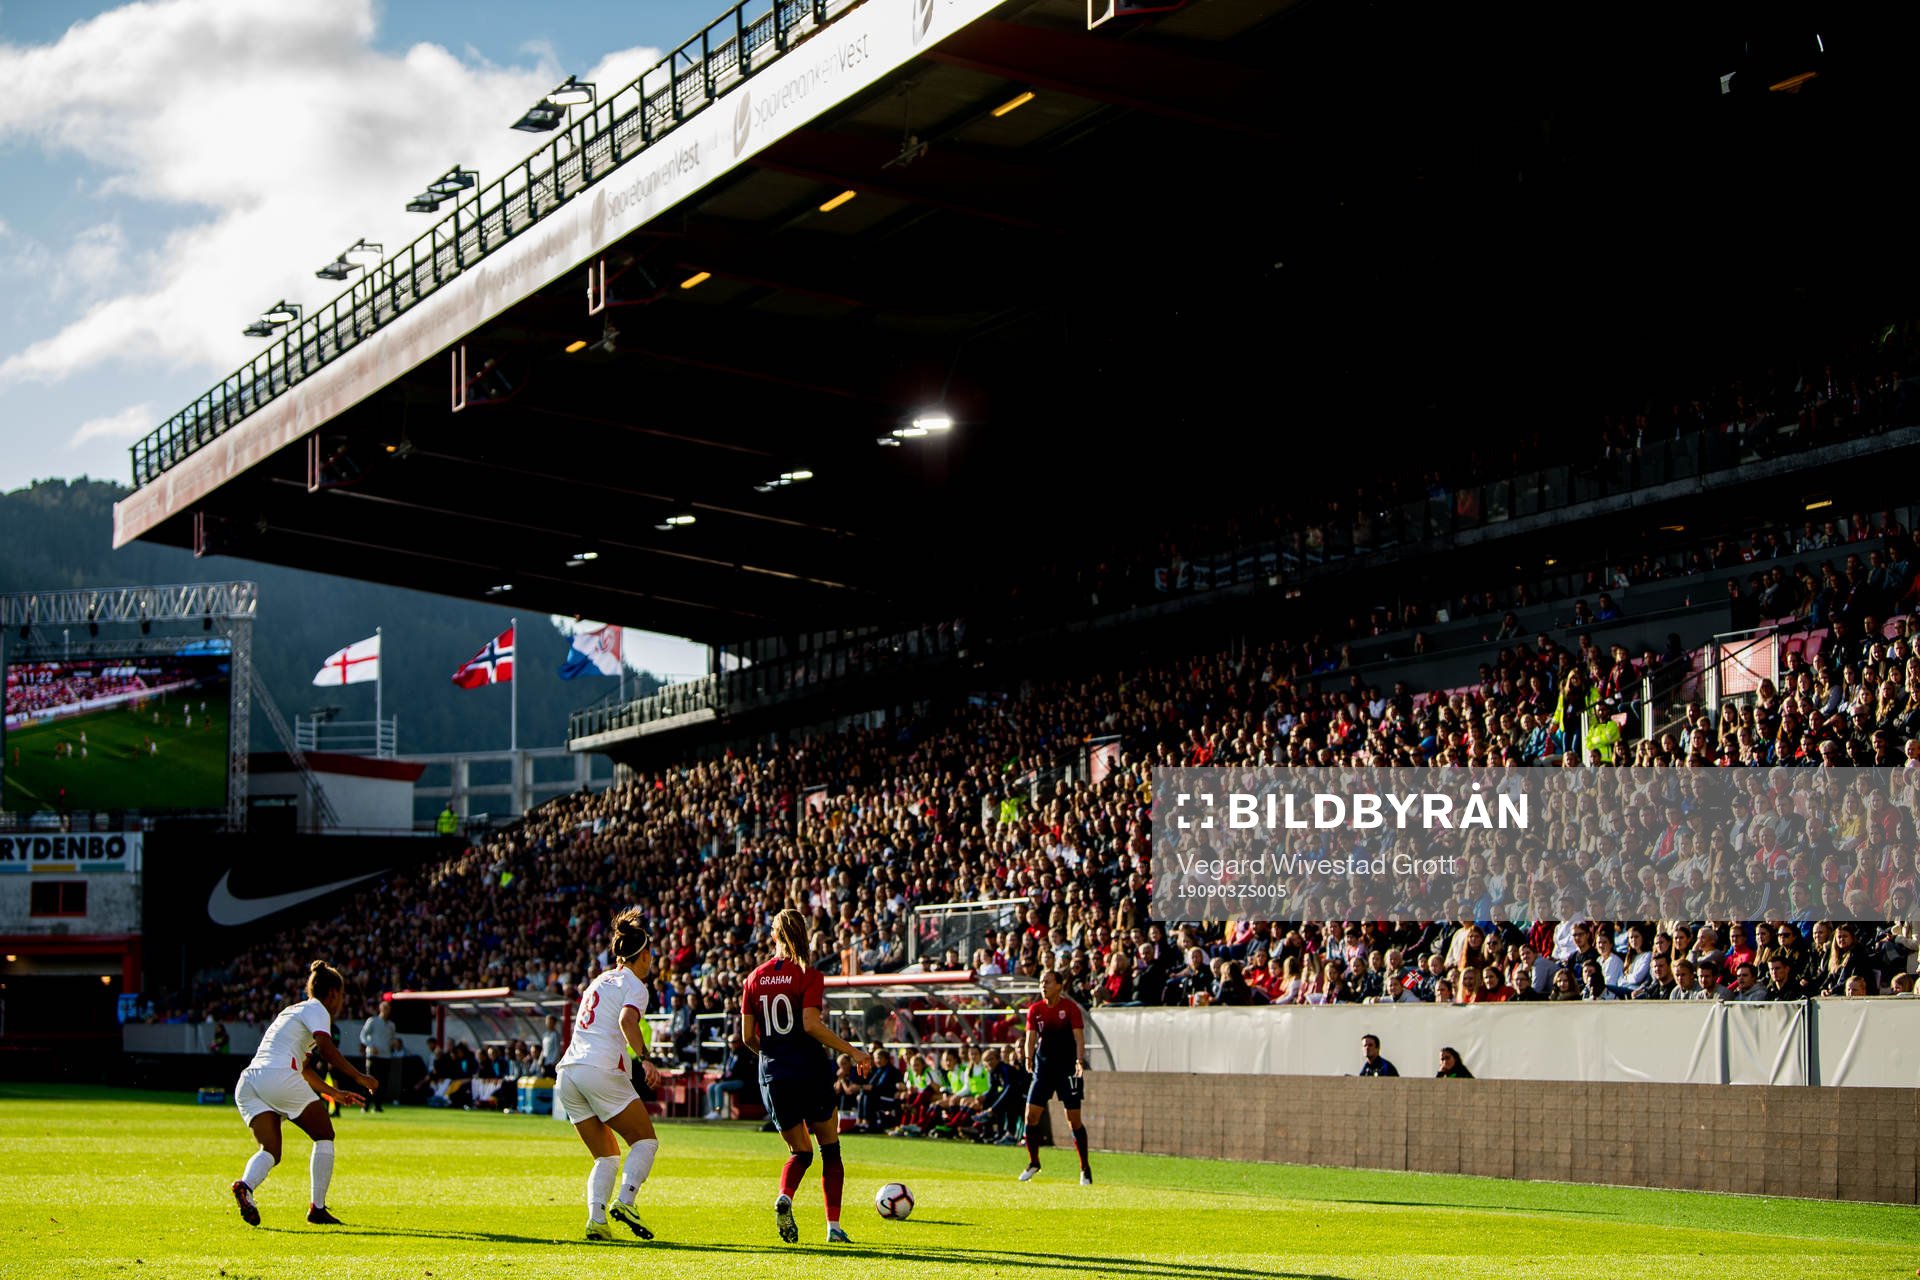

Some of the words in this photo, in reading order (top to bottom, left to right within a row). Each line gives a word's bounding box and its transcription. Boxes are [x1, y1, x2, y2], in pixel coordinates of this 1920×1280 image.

[0, 835, 126, 860] RYDENBØ
[760, 975, 792, 985] GRAHAM
[759, 993, 794, 1036] 10
